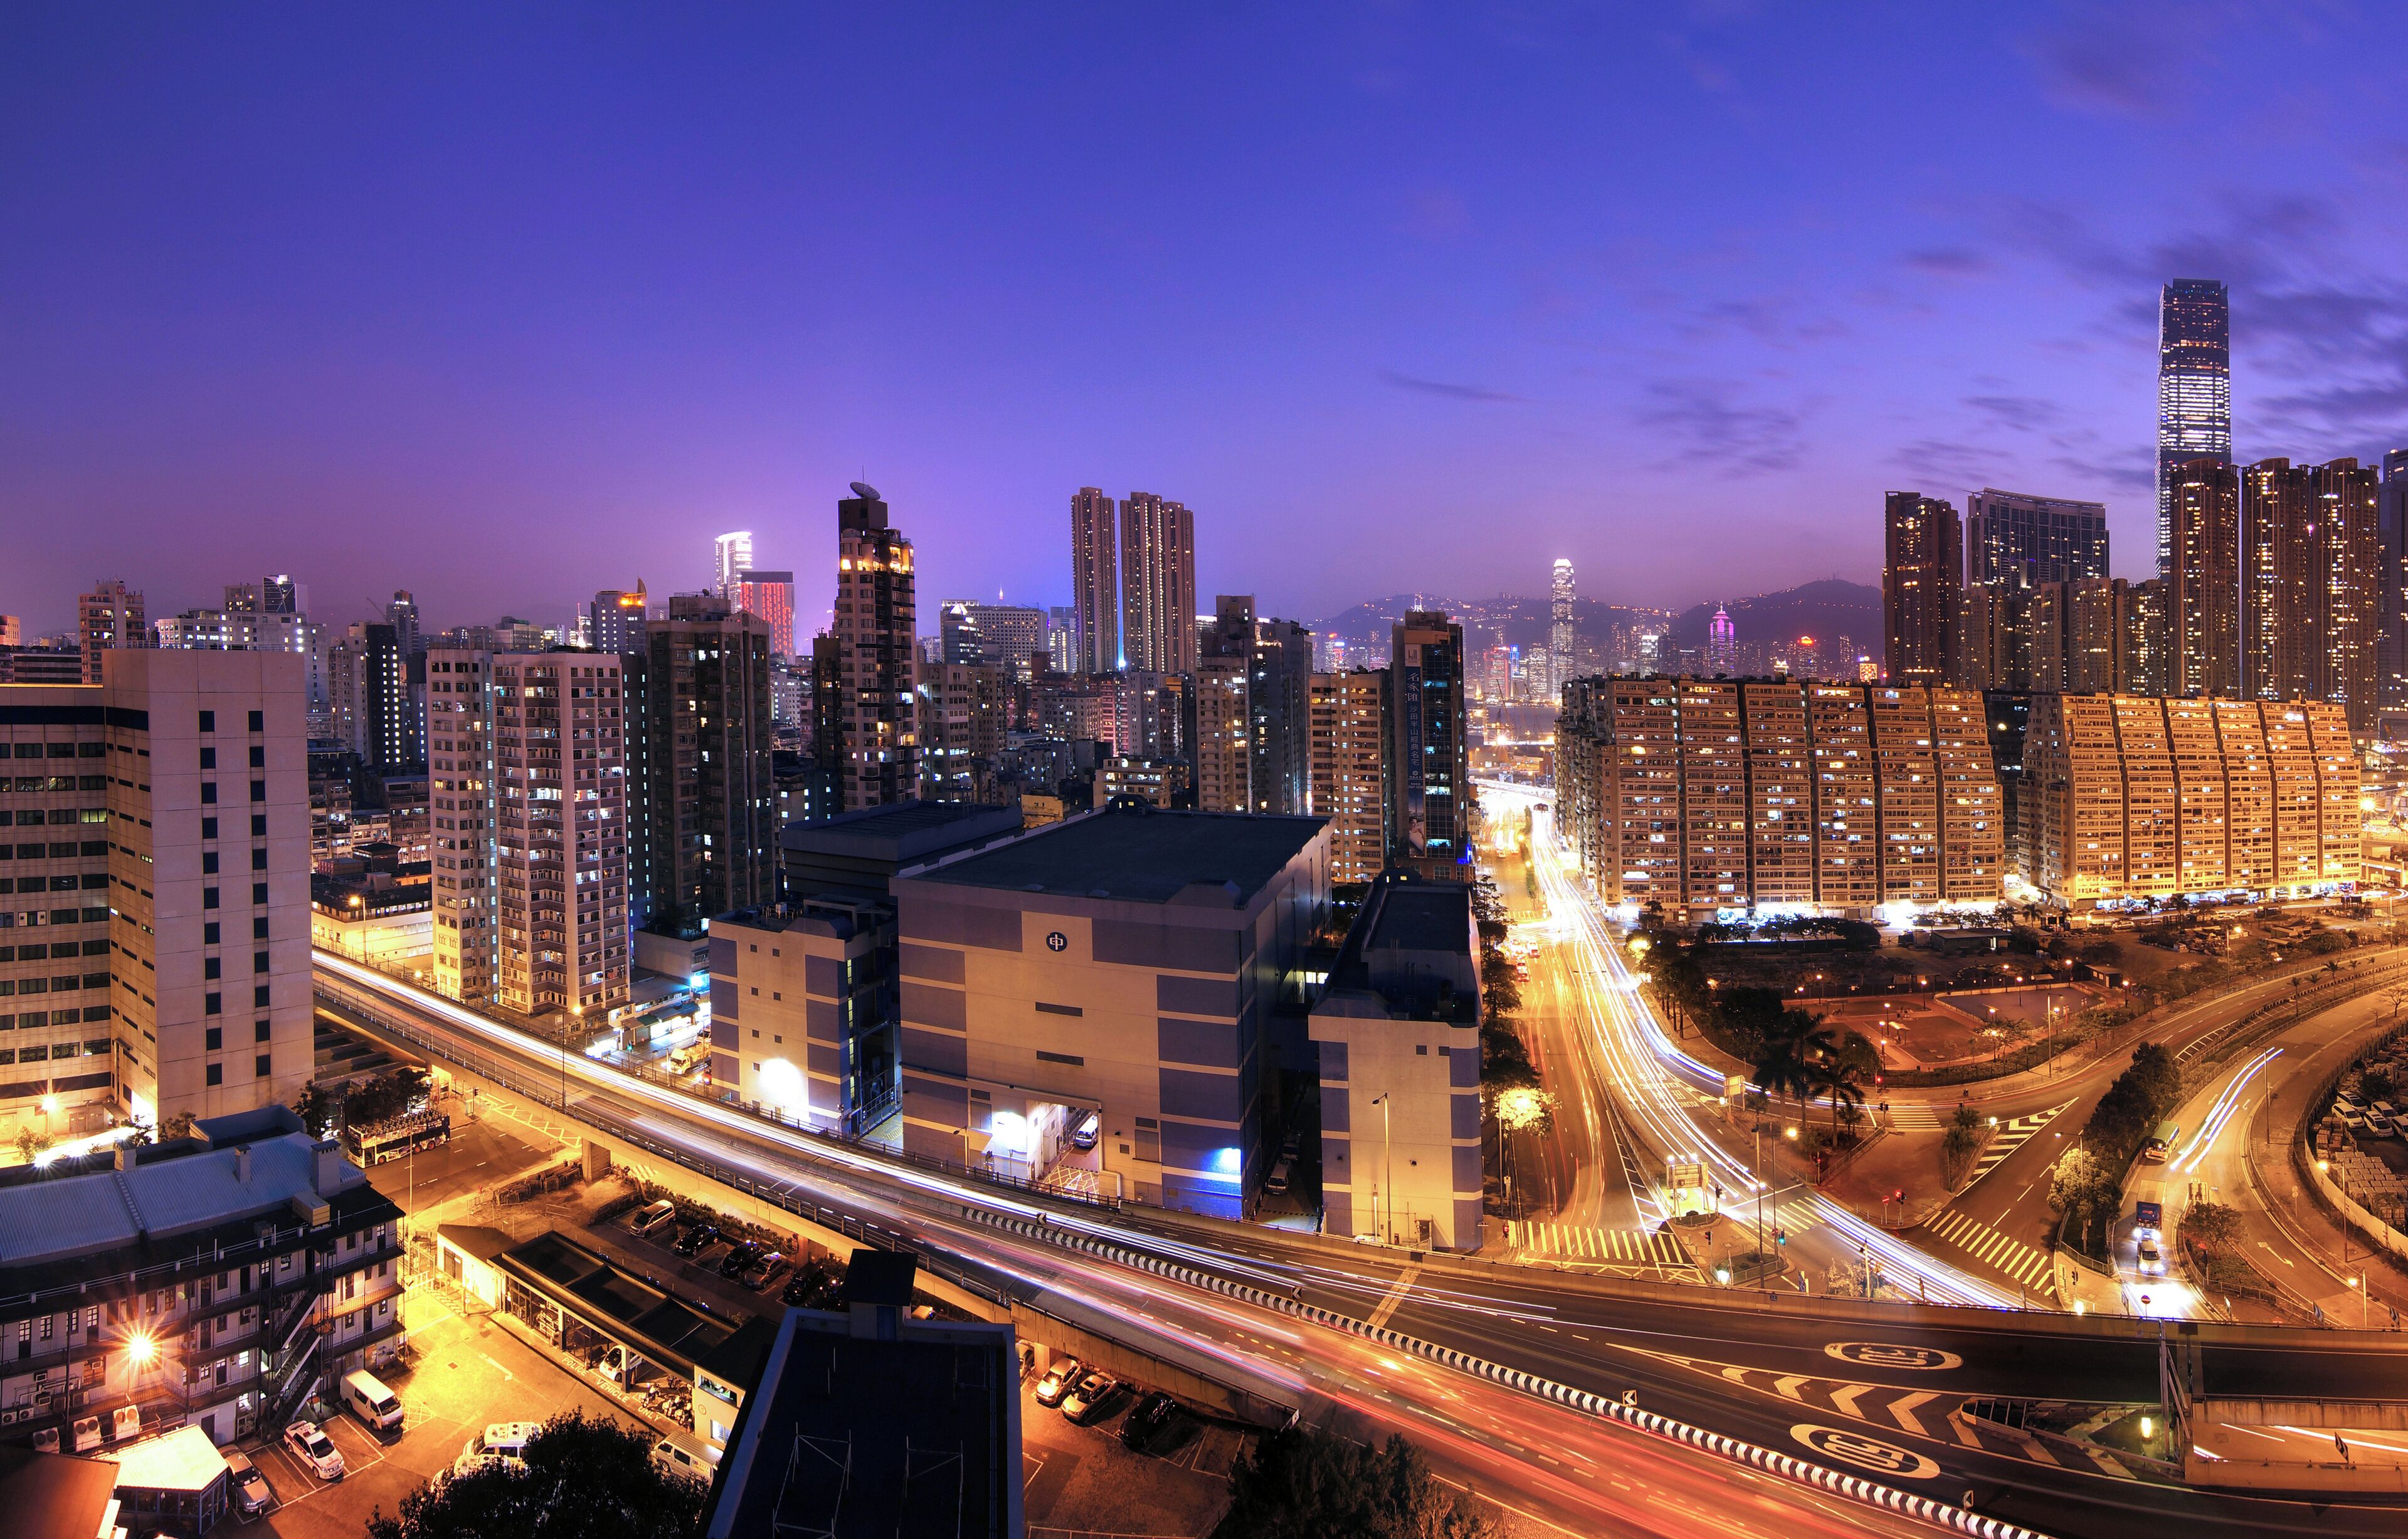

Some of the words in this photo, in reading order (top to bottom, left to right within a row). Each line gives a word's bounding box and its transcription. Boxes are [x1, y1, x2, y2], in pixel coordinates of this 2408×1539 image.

[561, 1357, 589, 1377] POLICE
[596, 1379, 630, 1403] VEHICLE
[638, 1406, 662, 1422] ONLY
